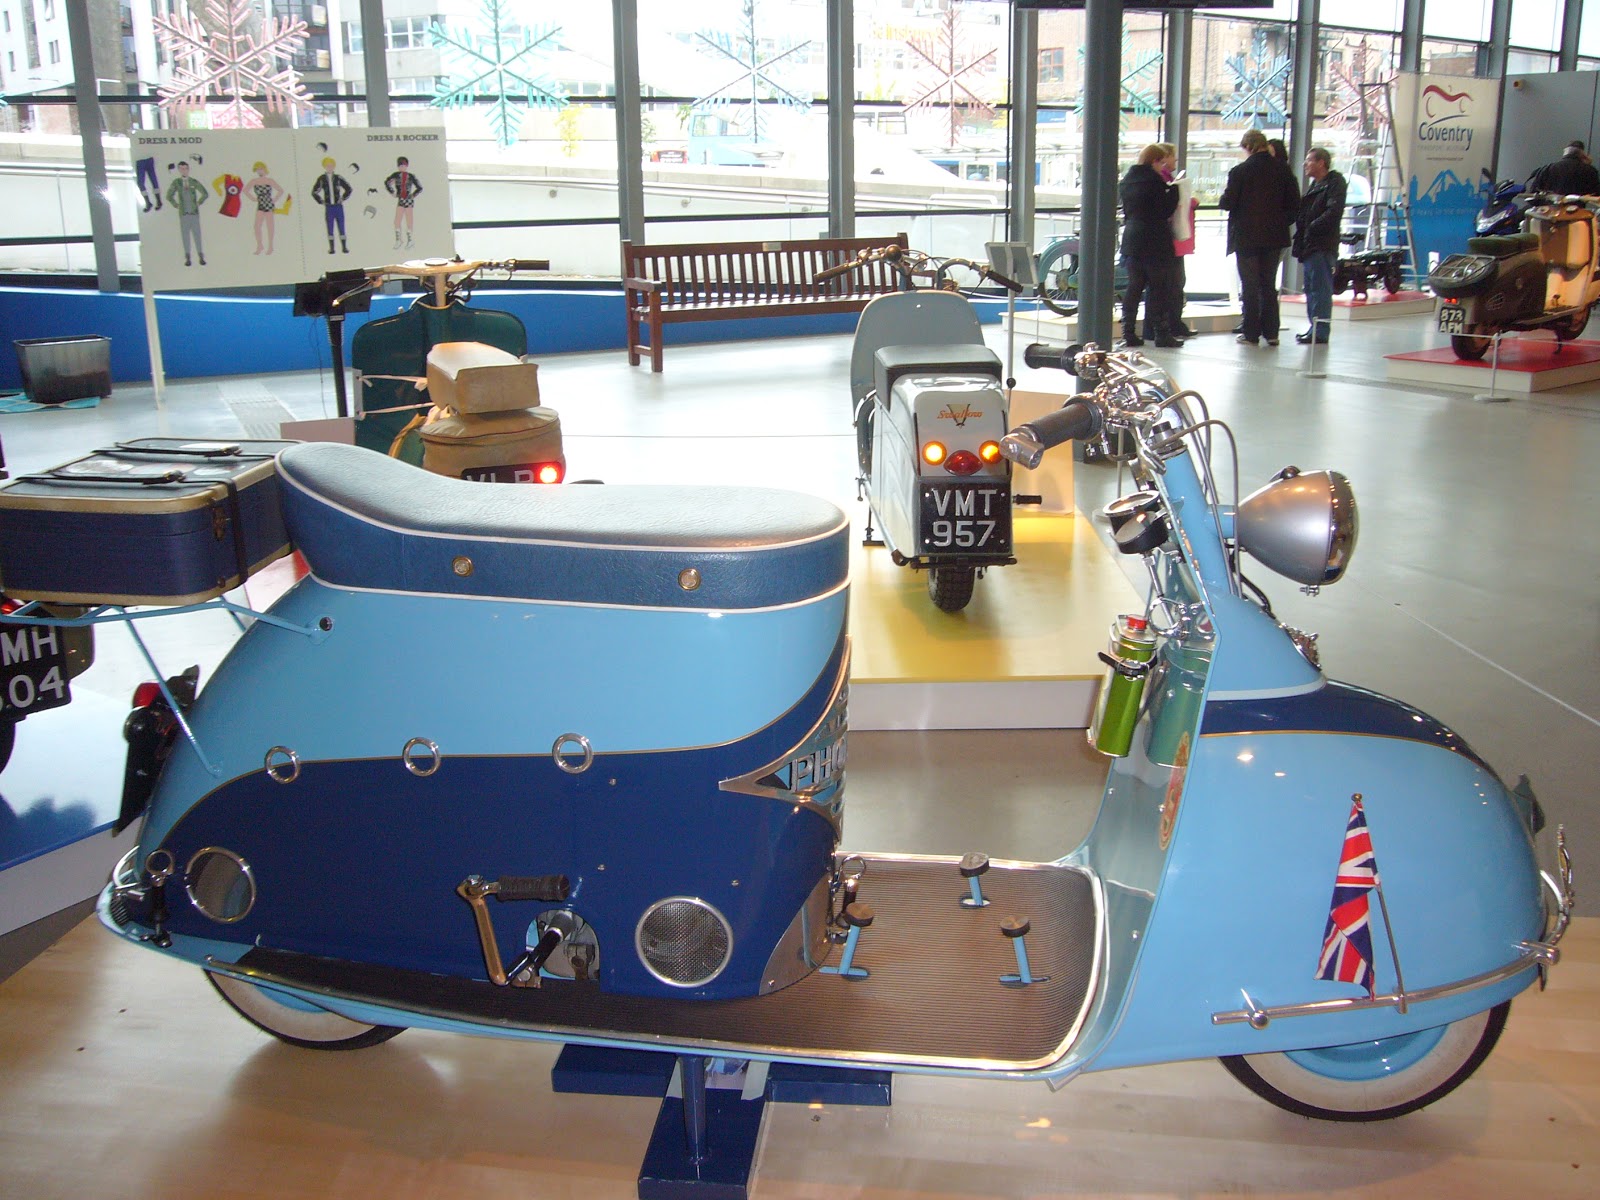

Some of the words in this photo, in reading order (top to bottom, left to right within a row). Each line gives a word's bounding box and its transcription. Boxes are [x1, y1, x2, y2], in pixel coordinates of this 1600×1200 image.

[138, 137, 168, 145] DRESS
[178, 136, 203, 144] MOD
[367, 134, 394, 142] DRESS
[395, 134, 402, 142] A
[402, 133, 439, 141] ROCKER
[1418, 121, 1473, 151] Coventry
[1440, 308, 1464, 321] 873
[936, 409, 984, 419] Swallow
[931, 488, 997, 517] VMT
[932, 520, 996, 547] 957
[0, 665, 64, 712] 04
